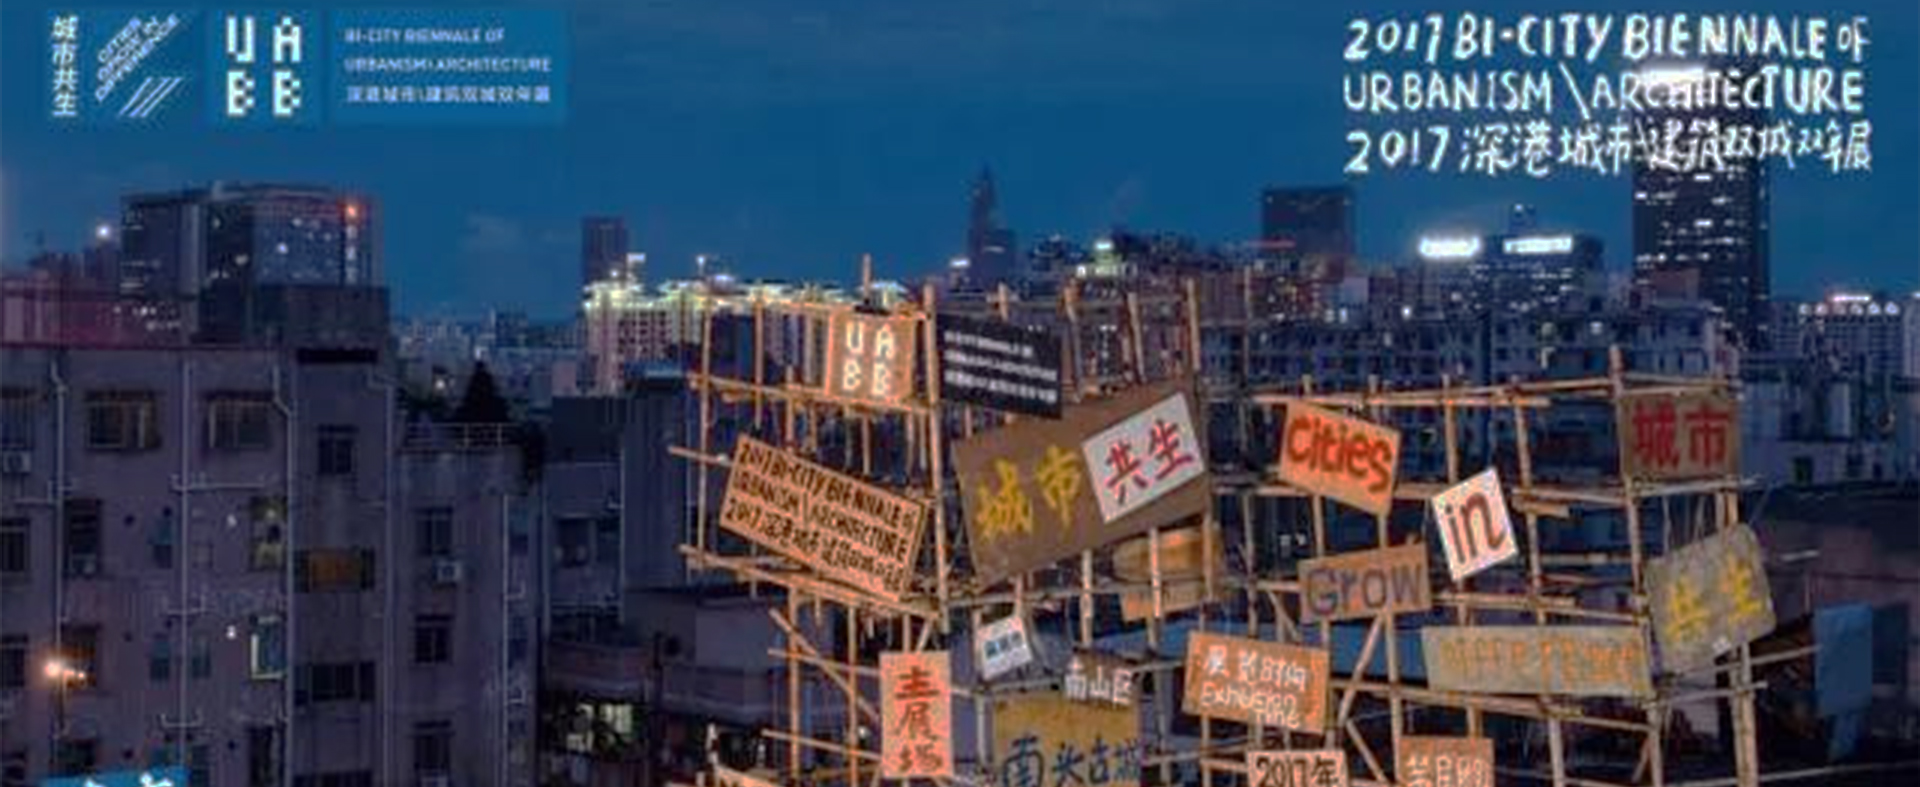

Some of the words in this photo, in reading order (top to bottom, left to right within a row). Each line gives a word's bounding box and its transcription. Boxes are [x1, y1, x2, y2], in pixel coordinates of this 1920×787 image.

[1105, 418, 1194, 505] 共生
[1633, 398, 1731, 470] 城市
[976, 445, 1083, 545] 城市
[1444, 492, 1507, 564] in
[1064, 654, 1133, 704] 南山区
